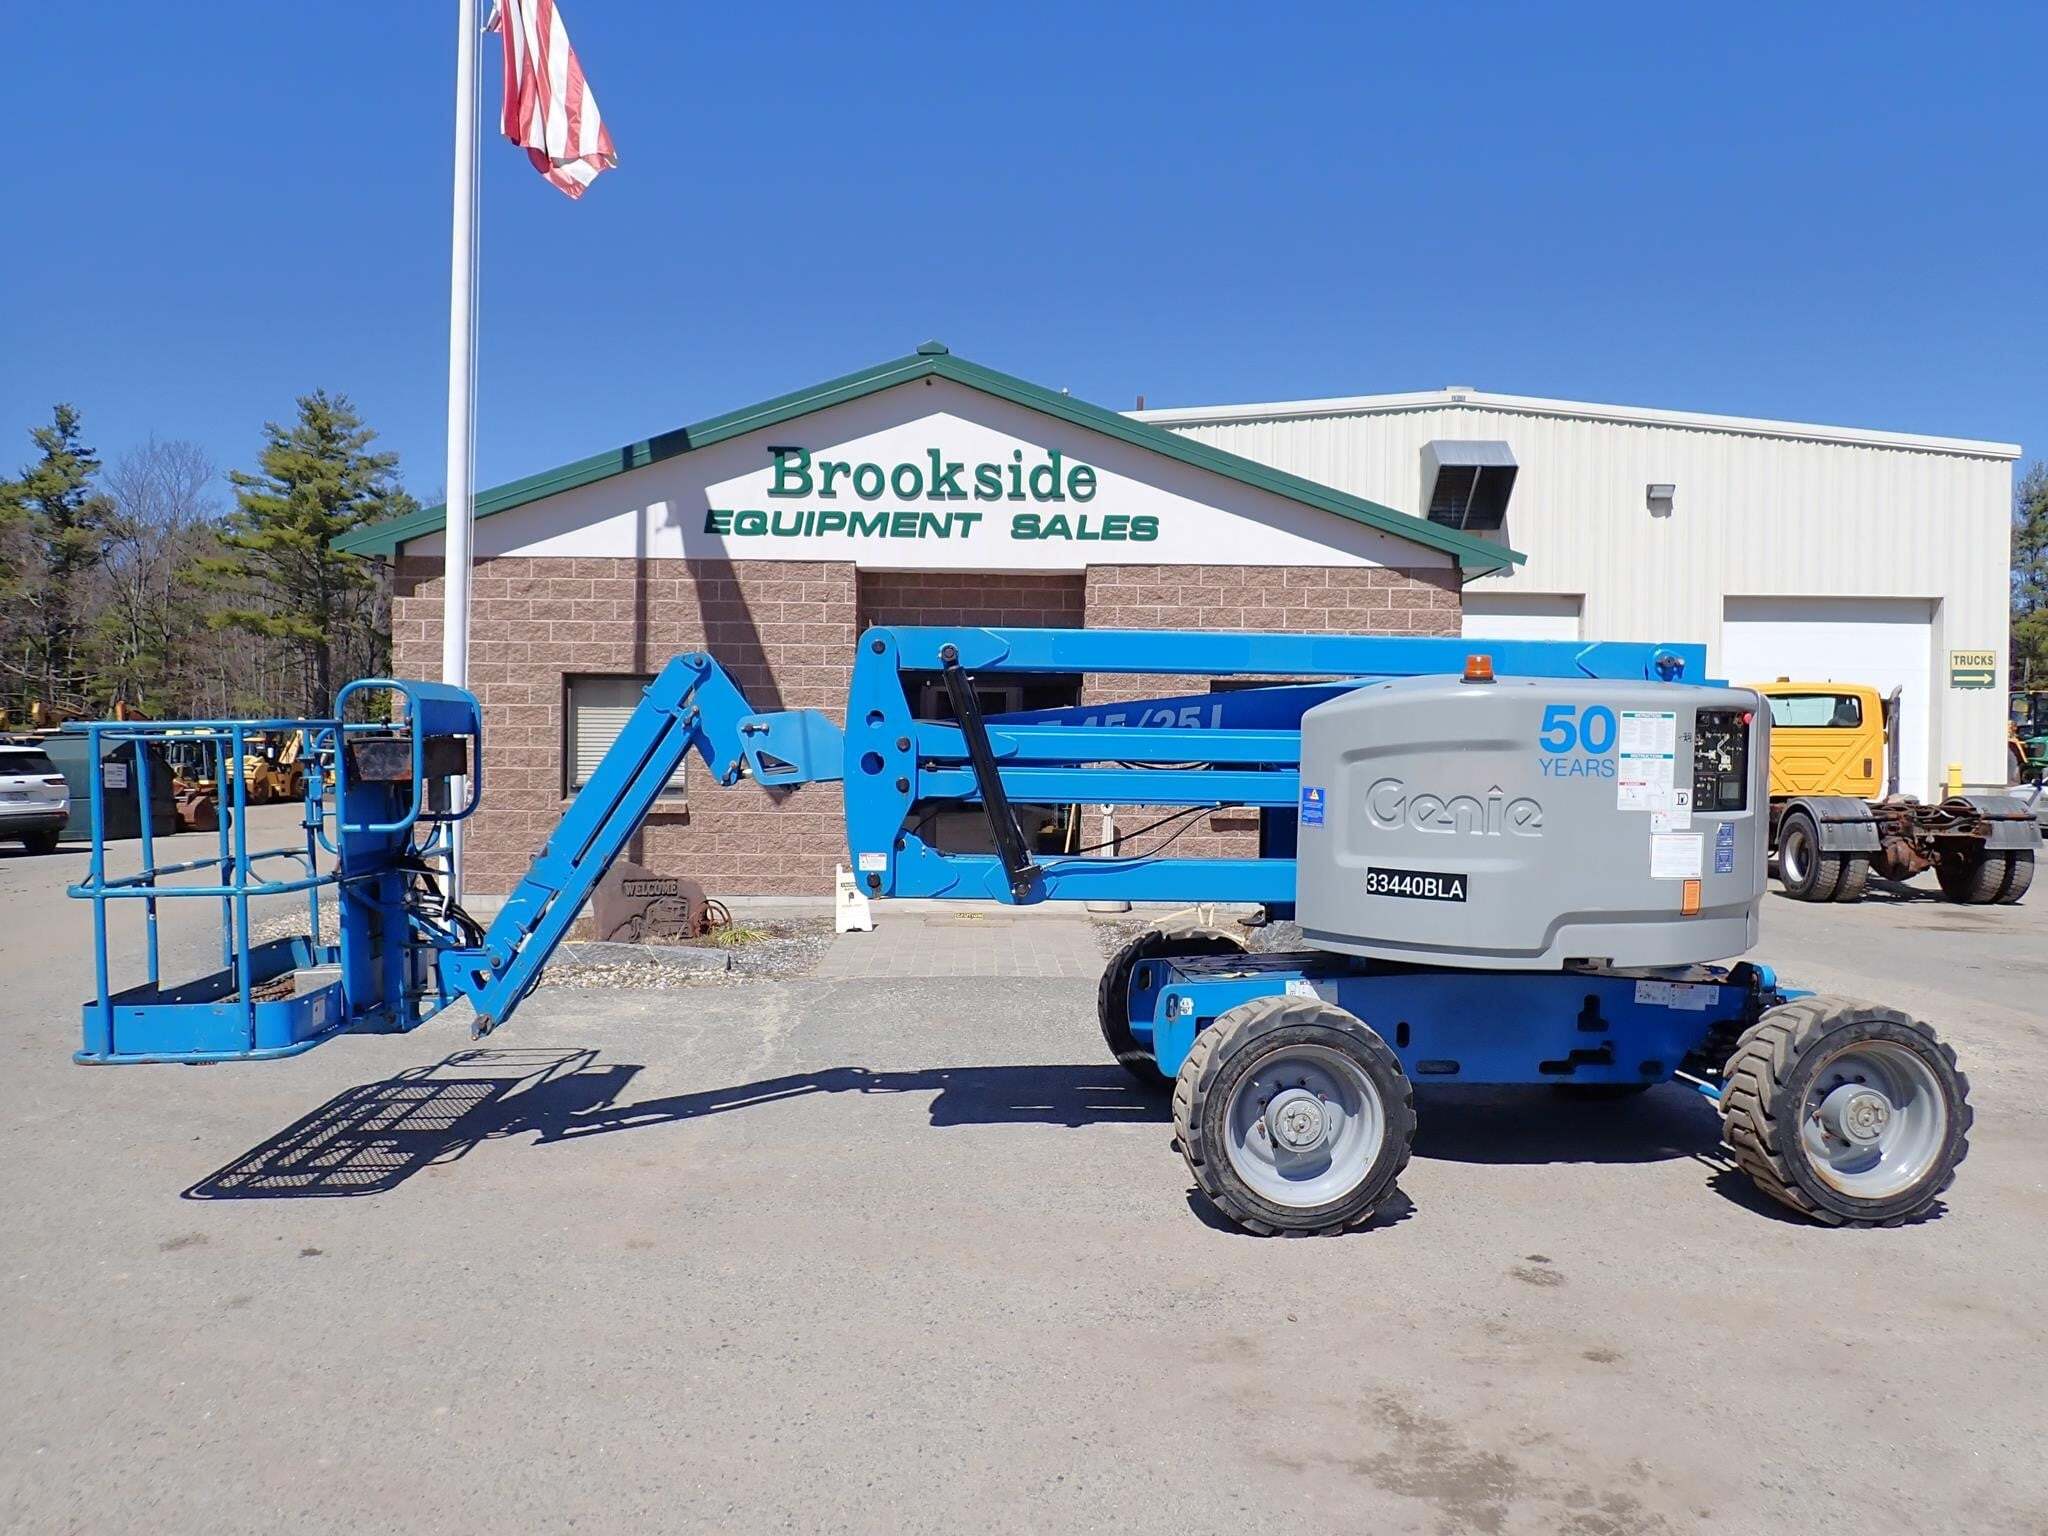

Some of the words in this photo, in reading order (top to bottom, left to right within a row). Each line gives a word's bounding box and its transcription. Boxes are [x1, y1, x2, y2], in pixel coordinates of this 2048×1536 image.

[767, 446, 1097, 502] Brookside
[704, 510, 982, 539] EQUIPMENT
[1010, 513, 1159, 541] SALES
[1953, 655, 1994, 666] TRUCKS
[1539, 704, 1617, 754] 50
[1539, 758, 1615, 777] YEARS
[1365, 777, 1543, 837] Genie
[622, 879, 679, 897] WELCOME
[1367, 873, 1464, 899] 33440BLA
